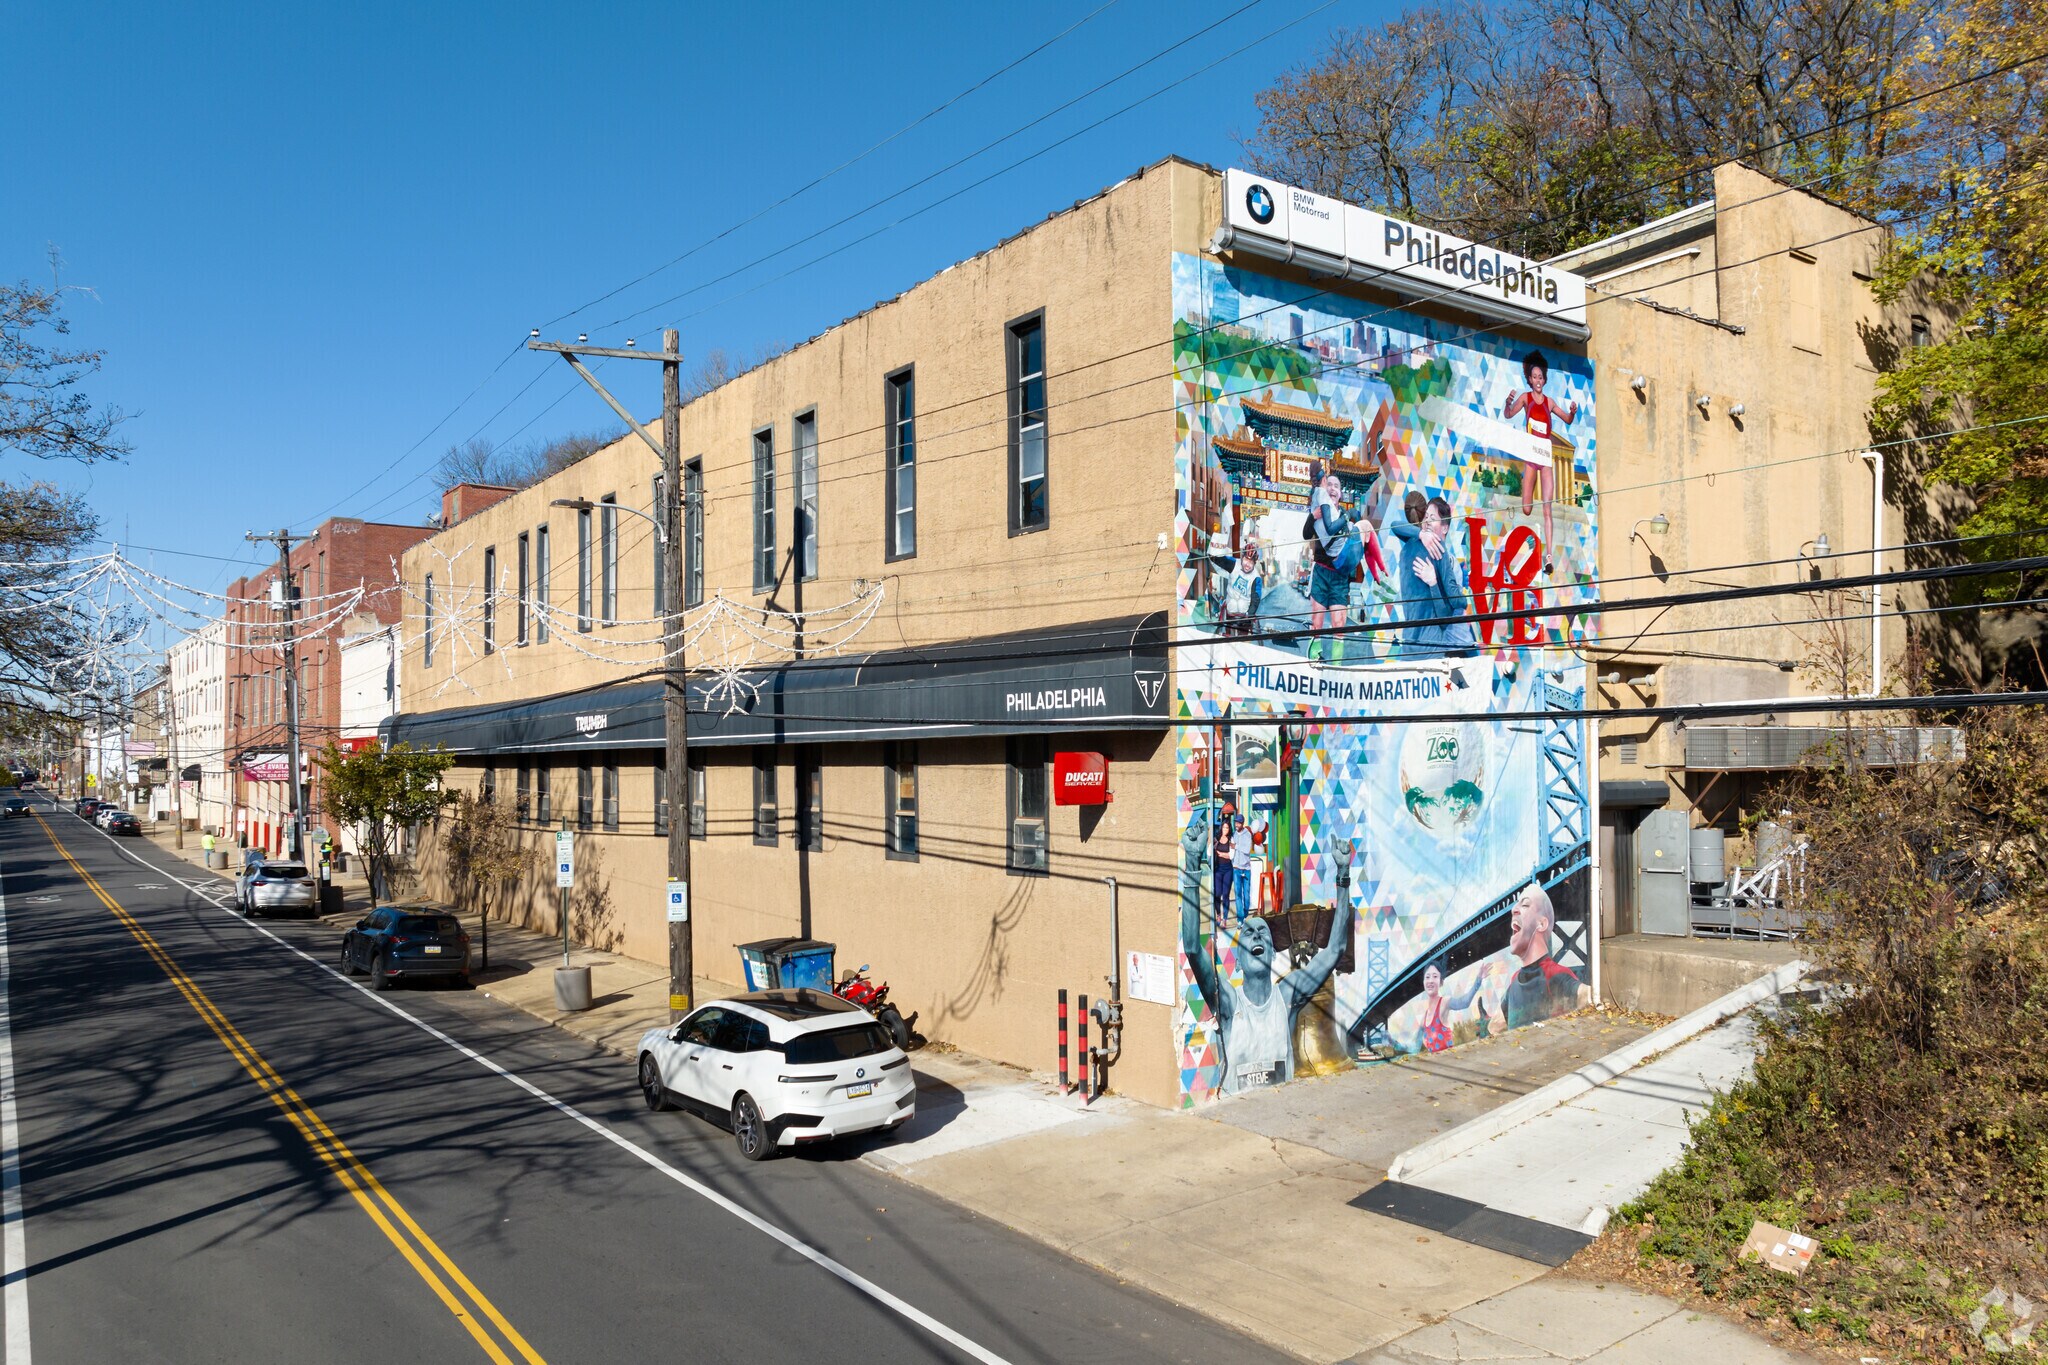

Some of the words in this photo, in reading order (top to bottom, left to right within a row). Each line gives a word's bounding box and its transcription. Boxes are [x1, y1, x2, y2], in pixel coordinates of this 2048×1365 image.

[1293, 192, 1315, 206] BMW
[1293, 202, 1330, 220] Motorrad
[1384, 219, 1558, 305] Philadelphia
[1236, 660, 1354, 700] PHILADELPHIA
[1359, 676, 1441, 700] MARATHON
[1006, 686, 1107, 712] PHILADELPHIA
[575, 714, 608, 734] TRIUMPH
[1426, 736, 1460, 761] ZOO
[1065, 772, 1104, 782] DUCATI
[1246, 1071, 1269, 1085] STEVE
